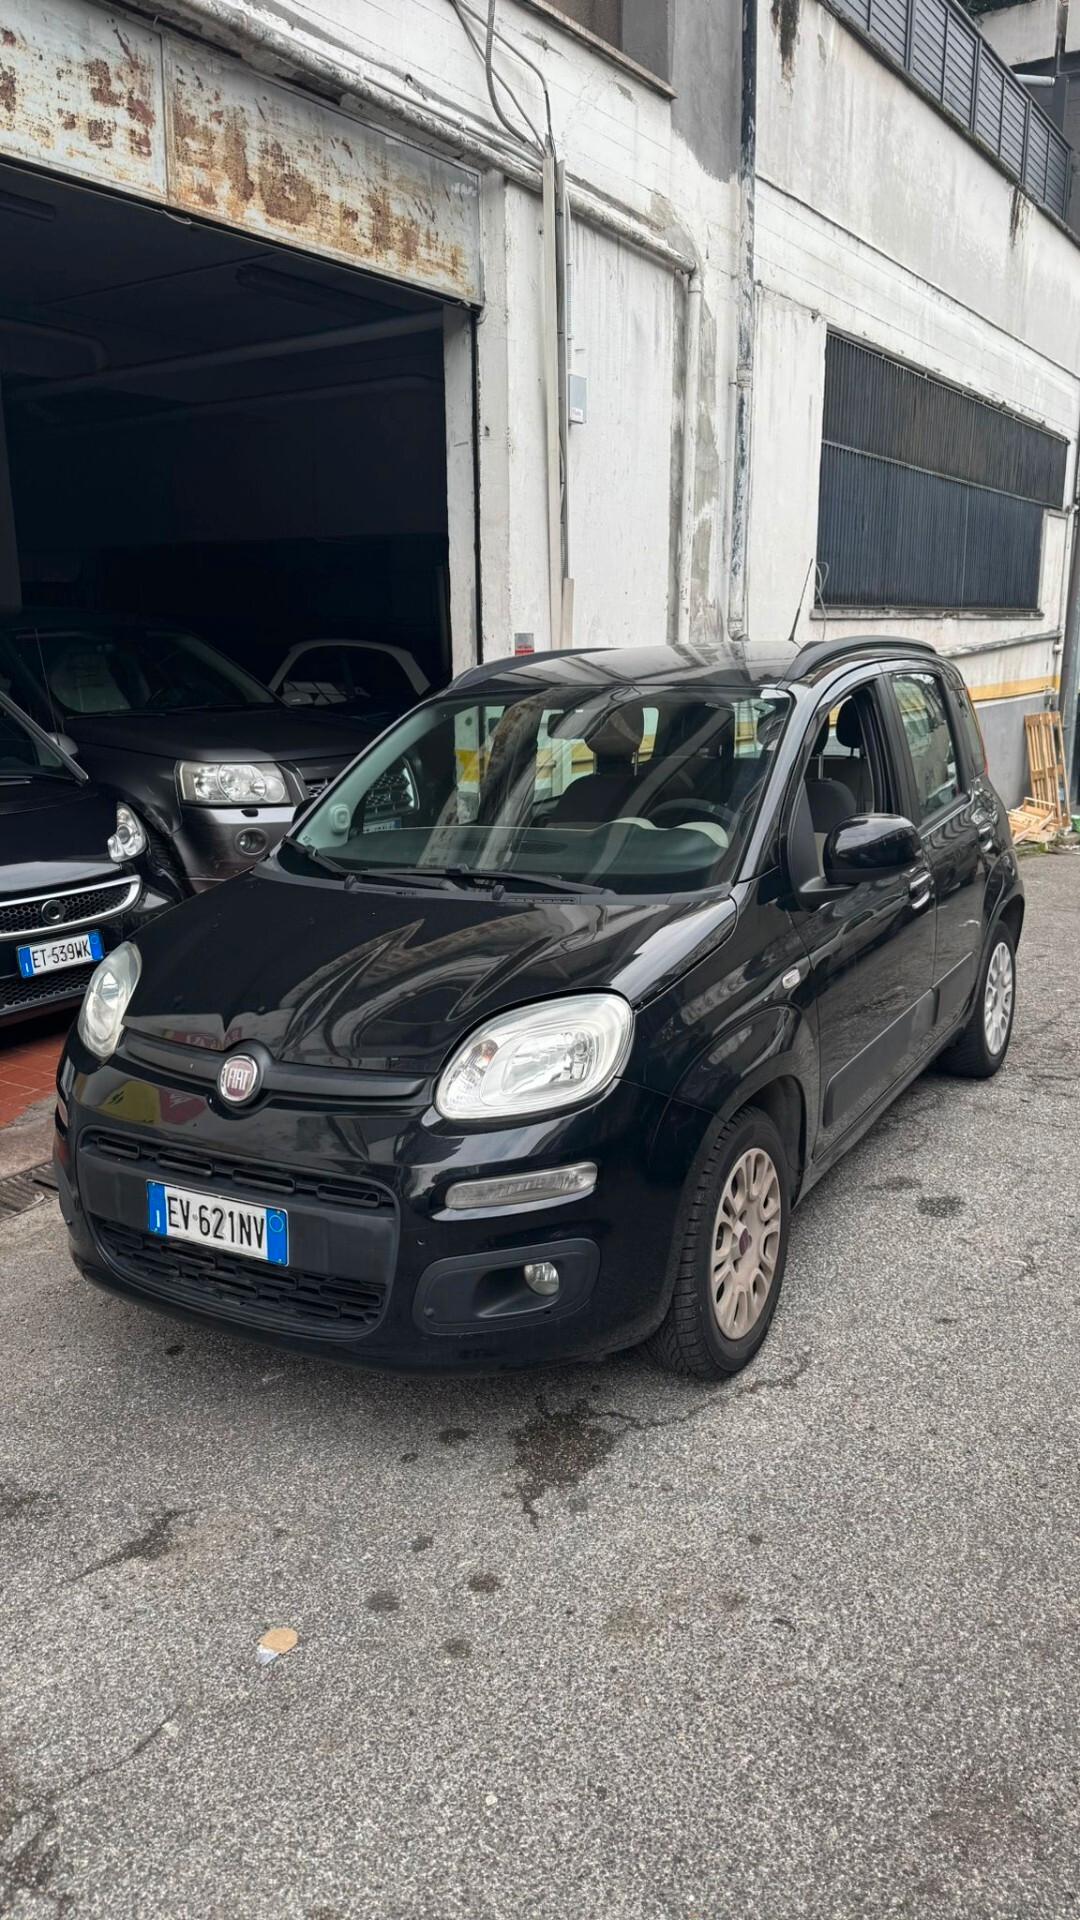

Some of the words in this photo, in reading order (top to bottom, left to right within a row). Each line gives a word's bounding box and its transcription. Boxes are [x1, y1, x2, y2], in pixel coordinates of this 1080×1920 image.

[32, 948, 47, 968] ET
[51, 940, 91, 964] 539WK
[227, 1067, 251, 1091] FIAT
[166, 1196, 190, 1230] EV
[198, 1204, 265, 1249] 621NV
